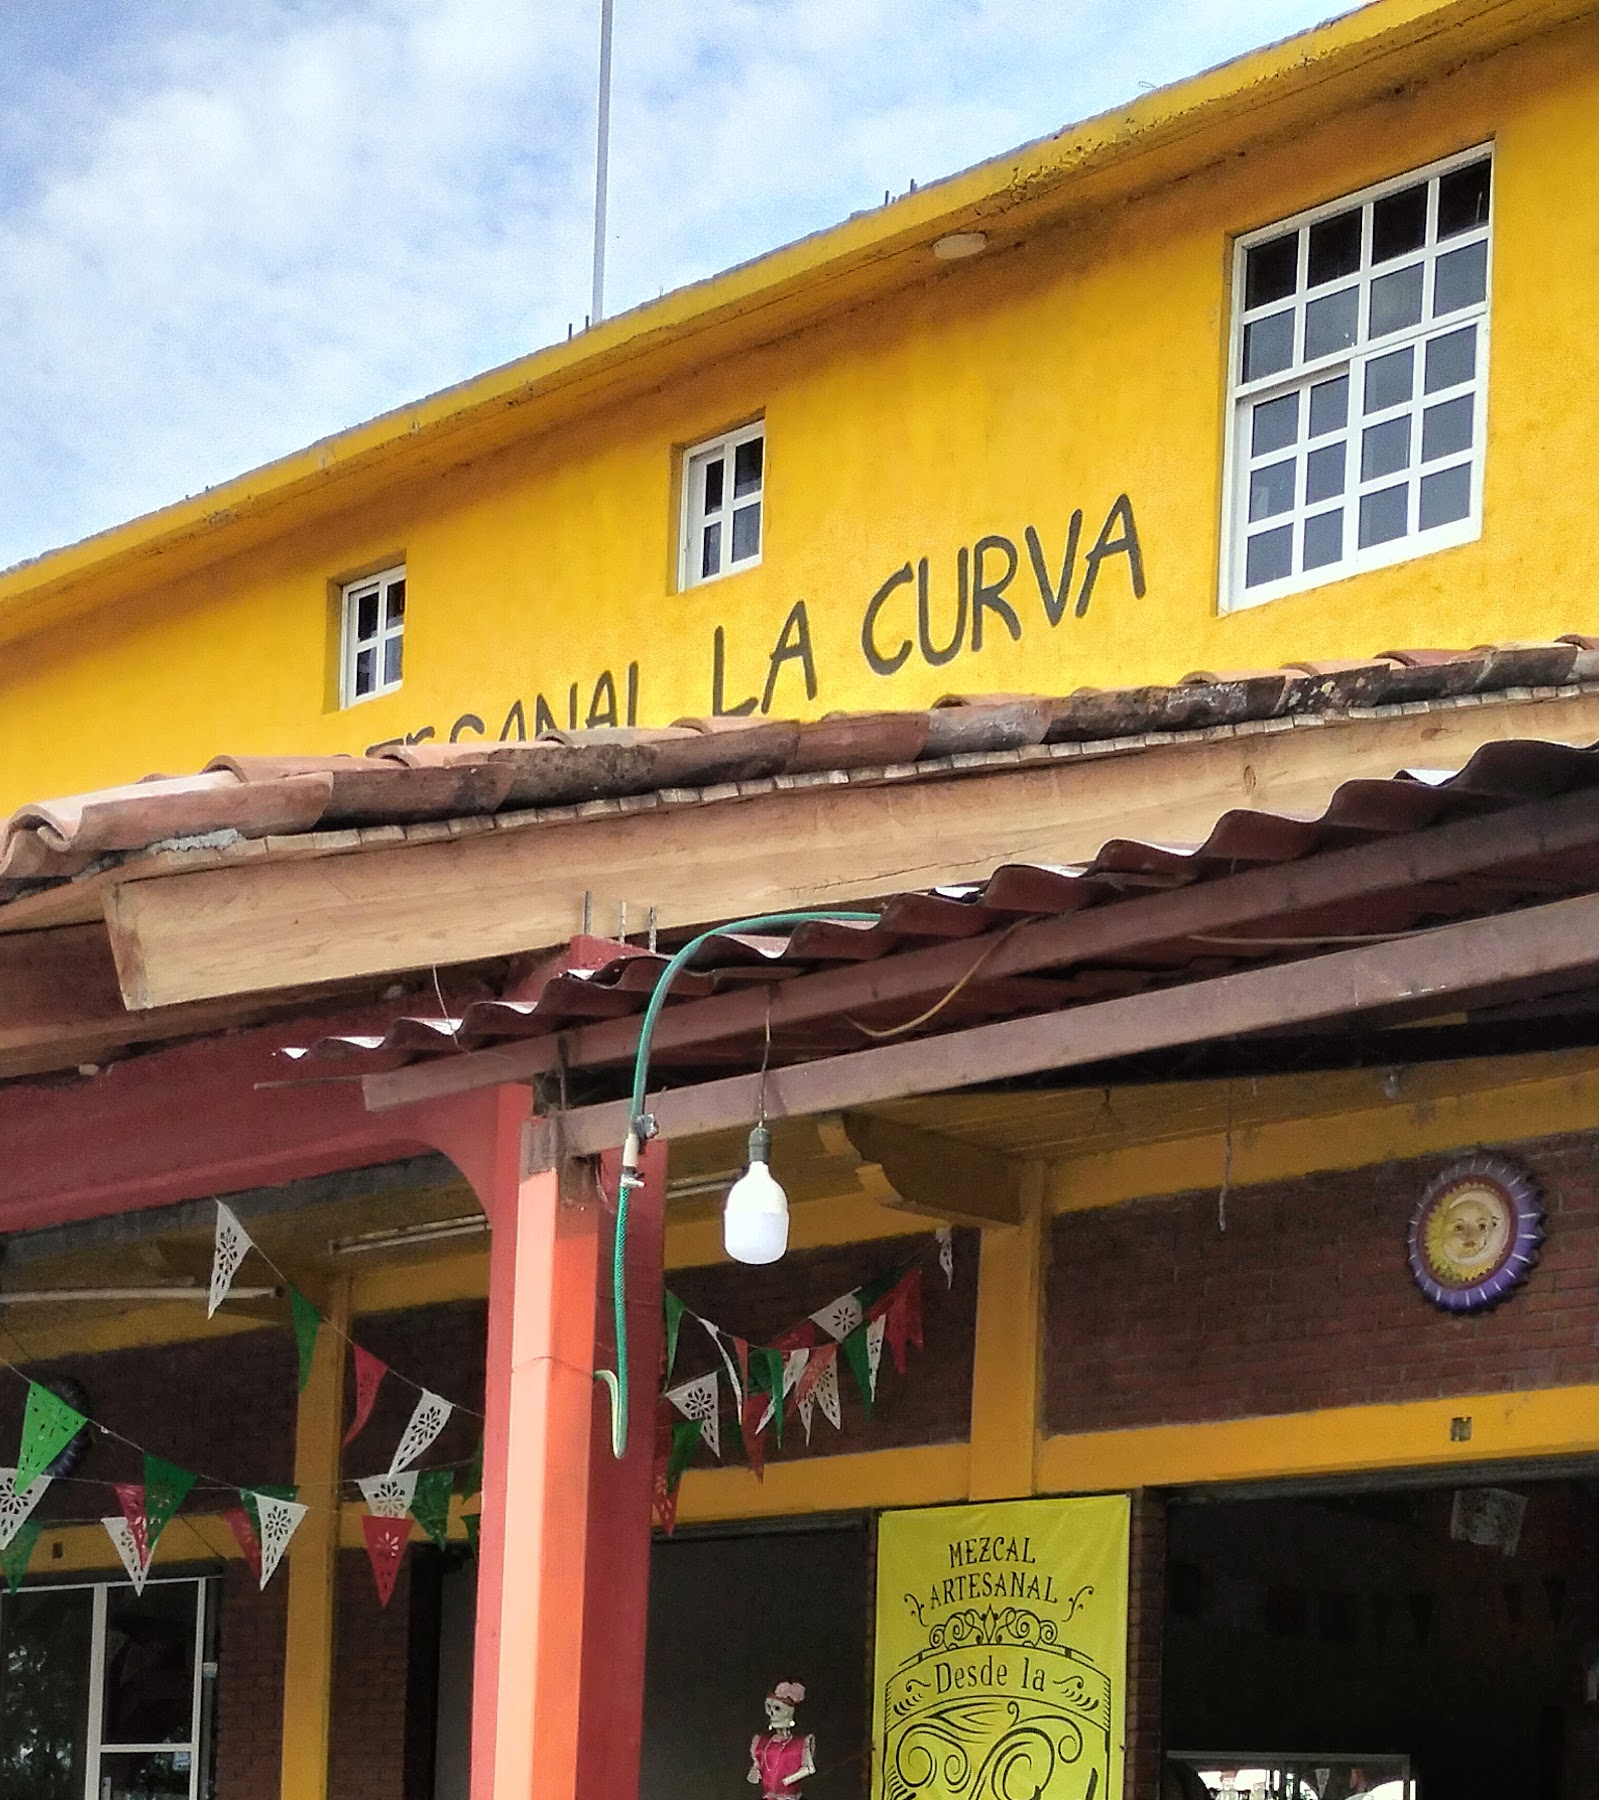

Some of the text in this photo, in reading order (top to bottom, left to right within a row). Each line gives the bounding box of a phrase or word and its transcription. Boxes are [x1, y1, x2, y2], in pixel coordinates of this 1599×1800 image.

[711, 600, 818, 719] LA
[860, 493, 1148, 677] CURVA
[948, 1536, 1037, 1569] MEZCAL
[929, 1571, 1059, 1610] ARTESANAL
[934, 1655, 1046, 1695] Desde la
